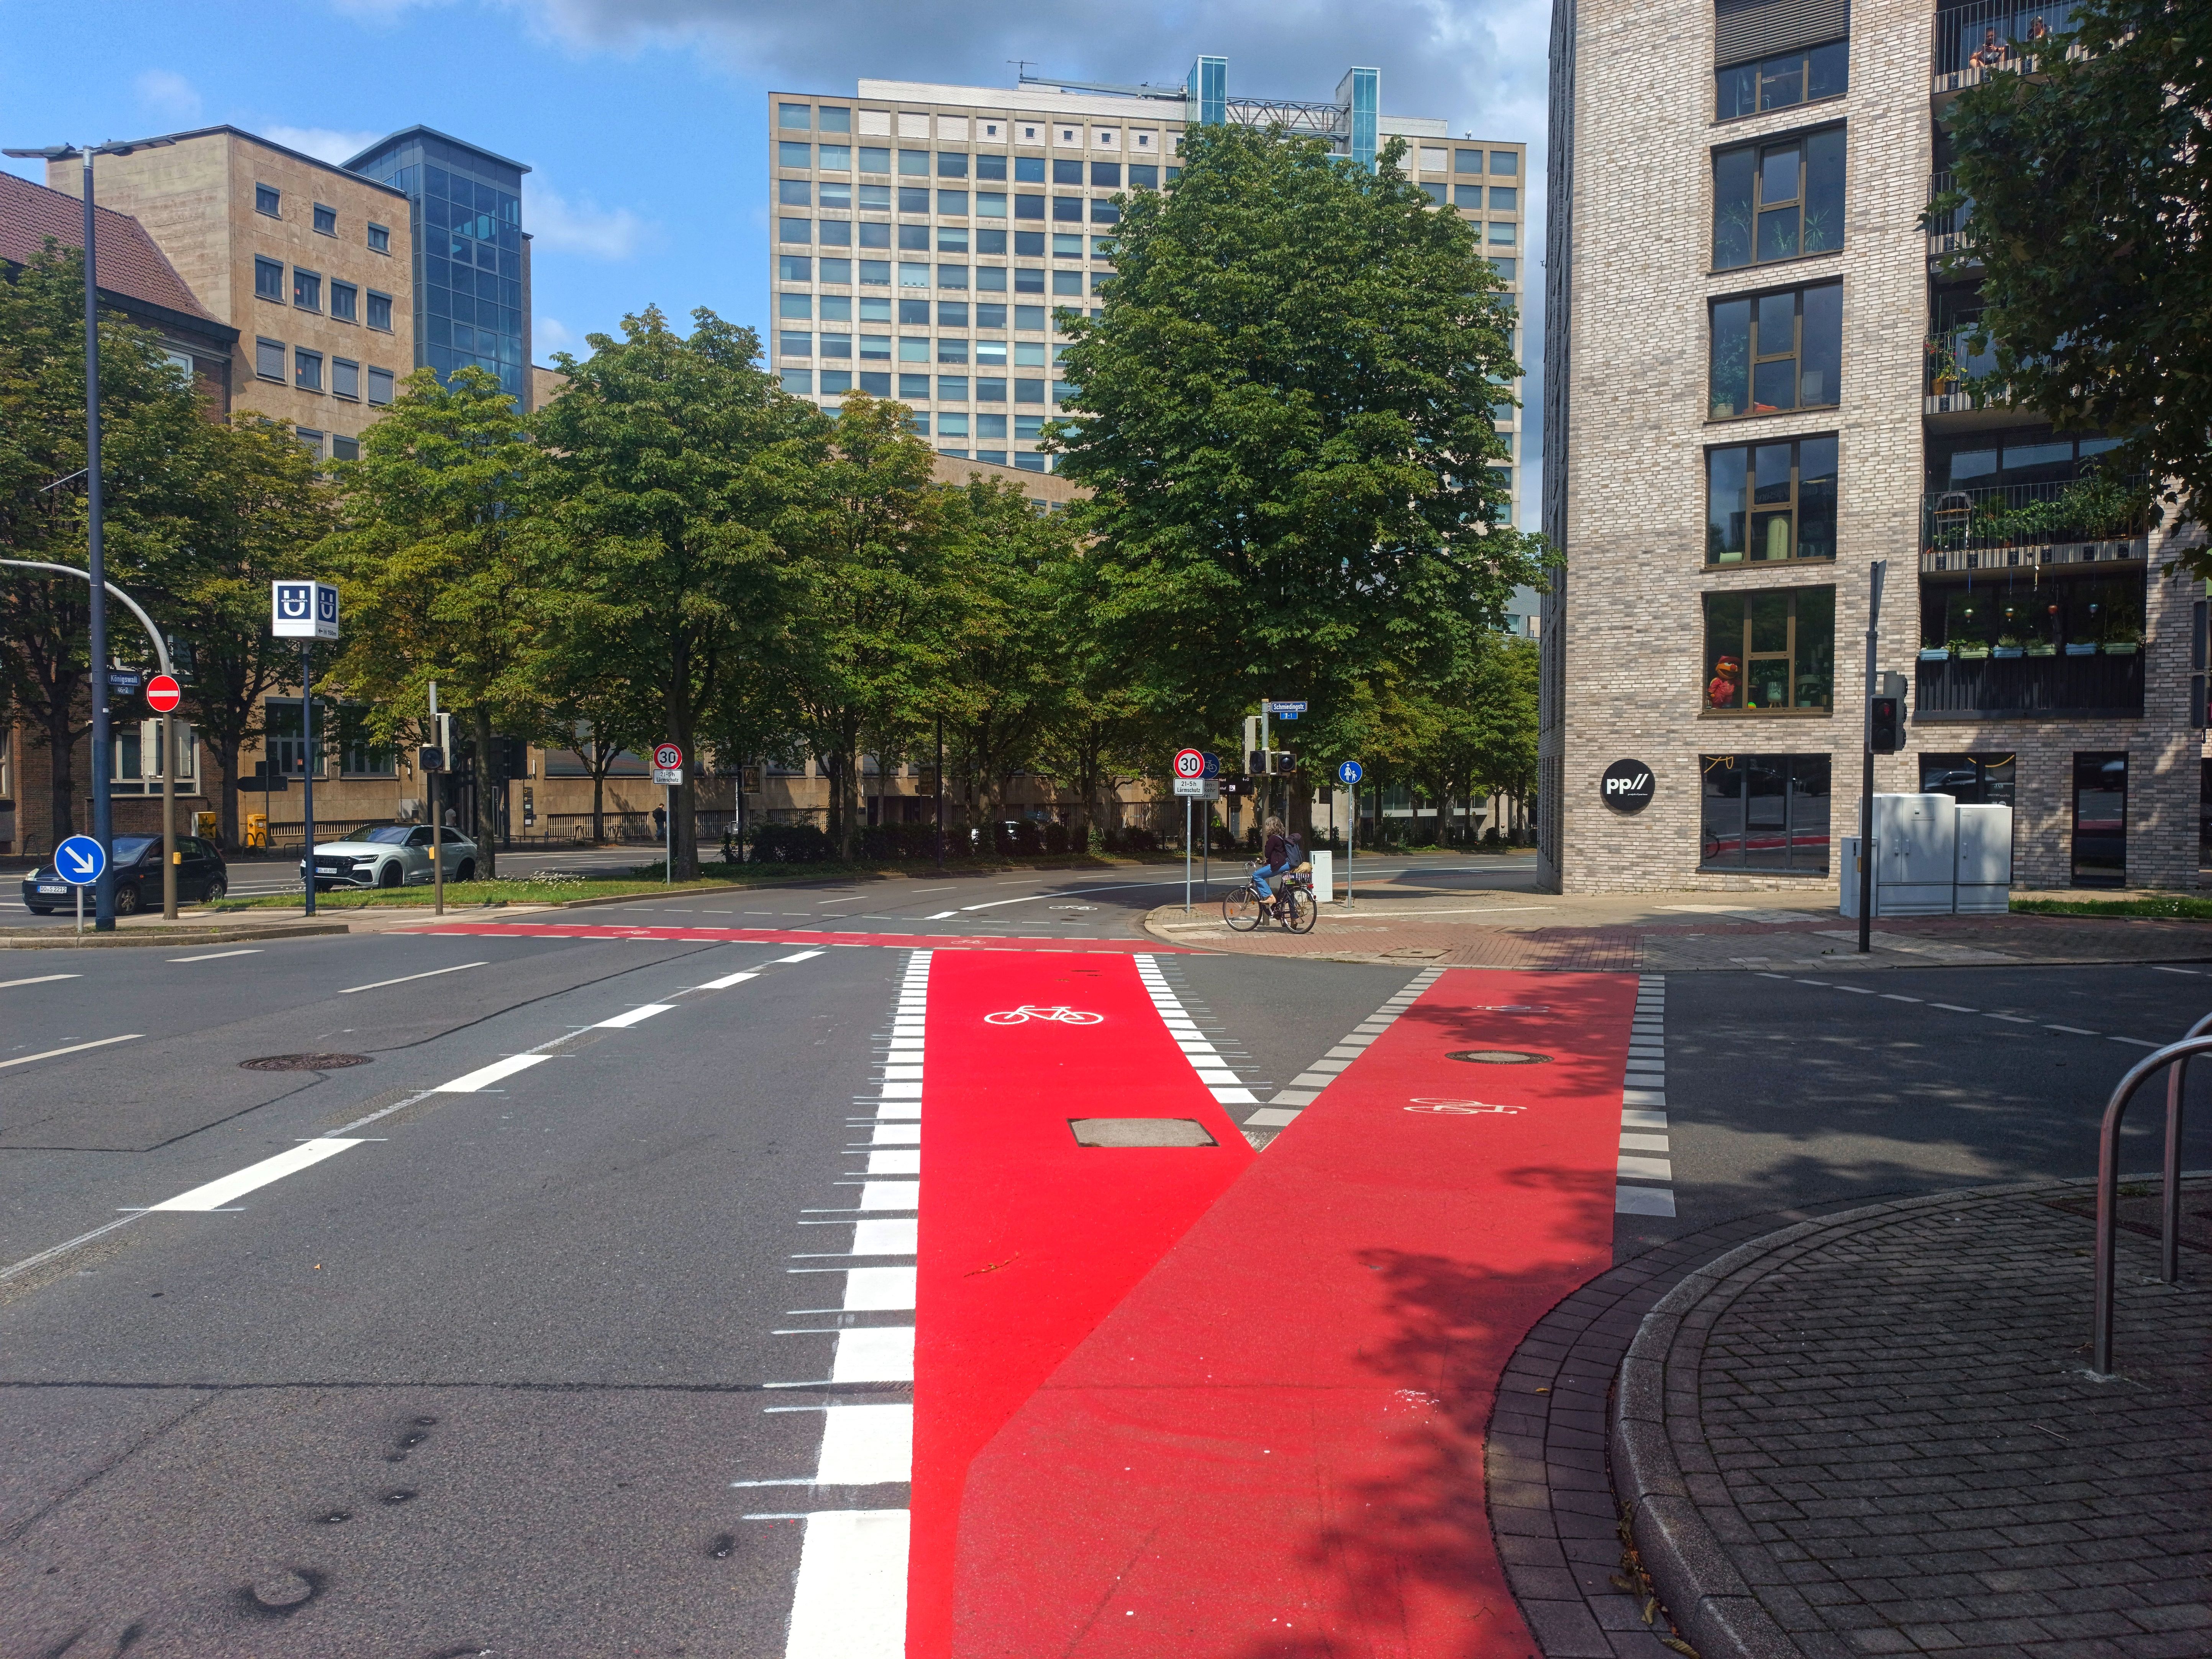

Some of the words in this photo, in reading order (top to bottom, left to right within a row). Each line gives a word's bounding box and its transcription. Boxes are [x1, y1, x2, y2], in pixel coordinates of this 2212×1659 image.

[110, 674, 138, 684] Königswall
[660, 751, 676, 764] 30
[1181, 757, 1197, 771] 30
